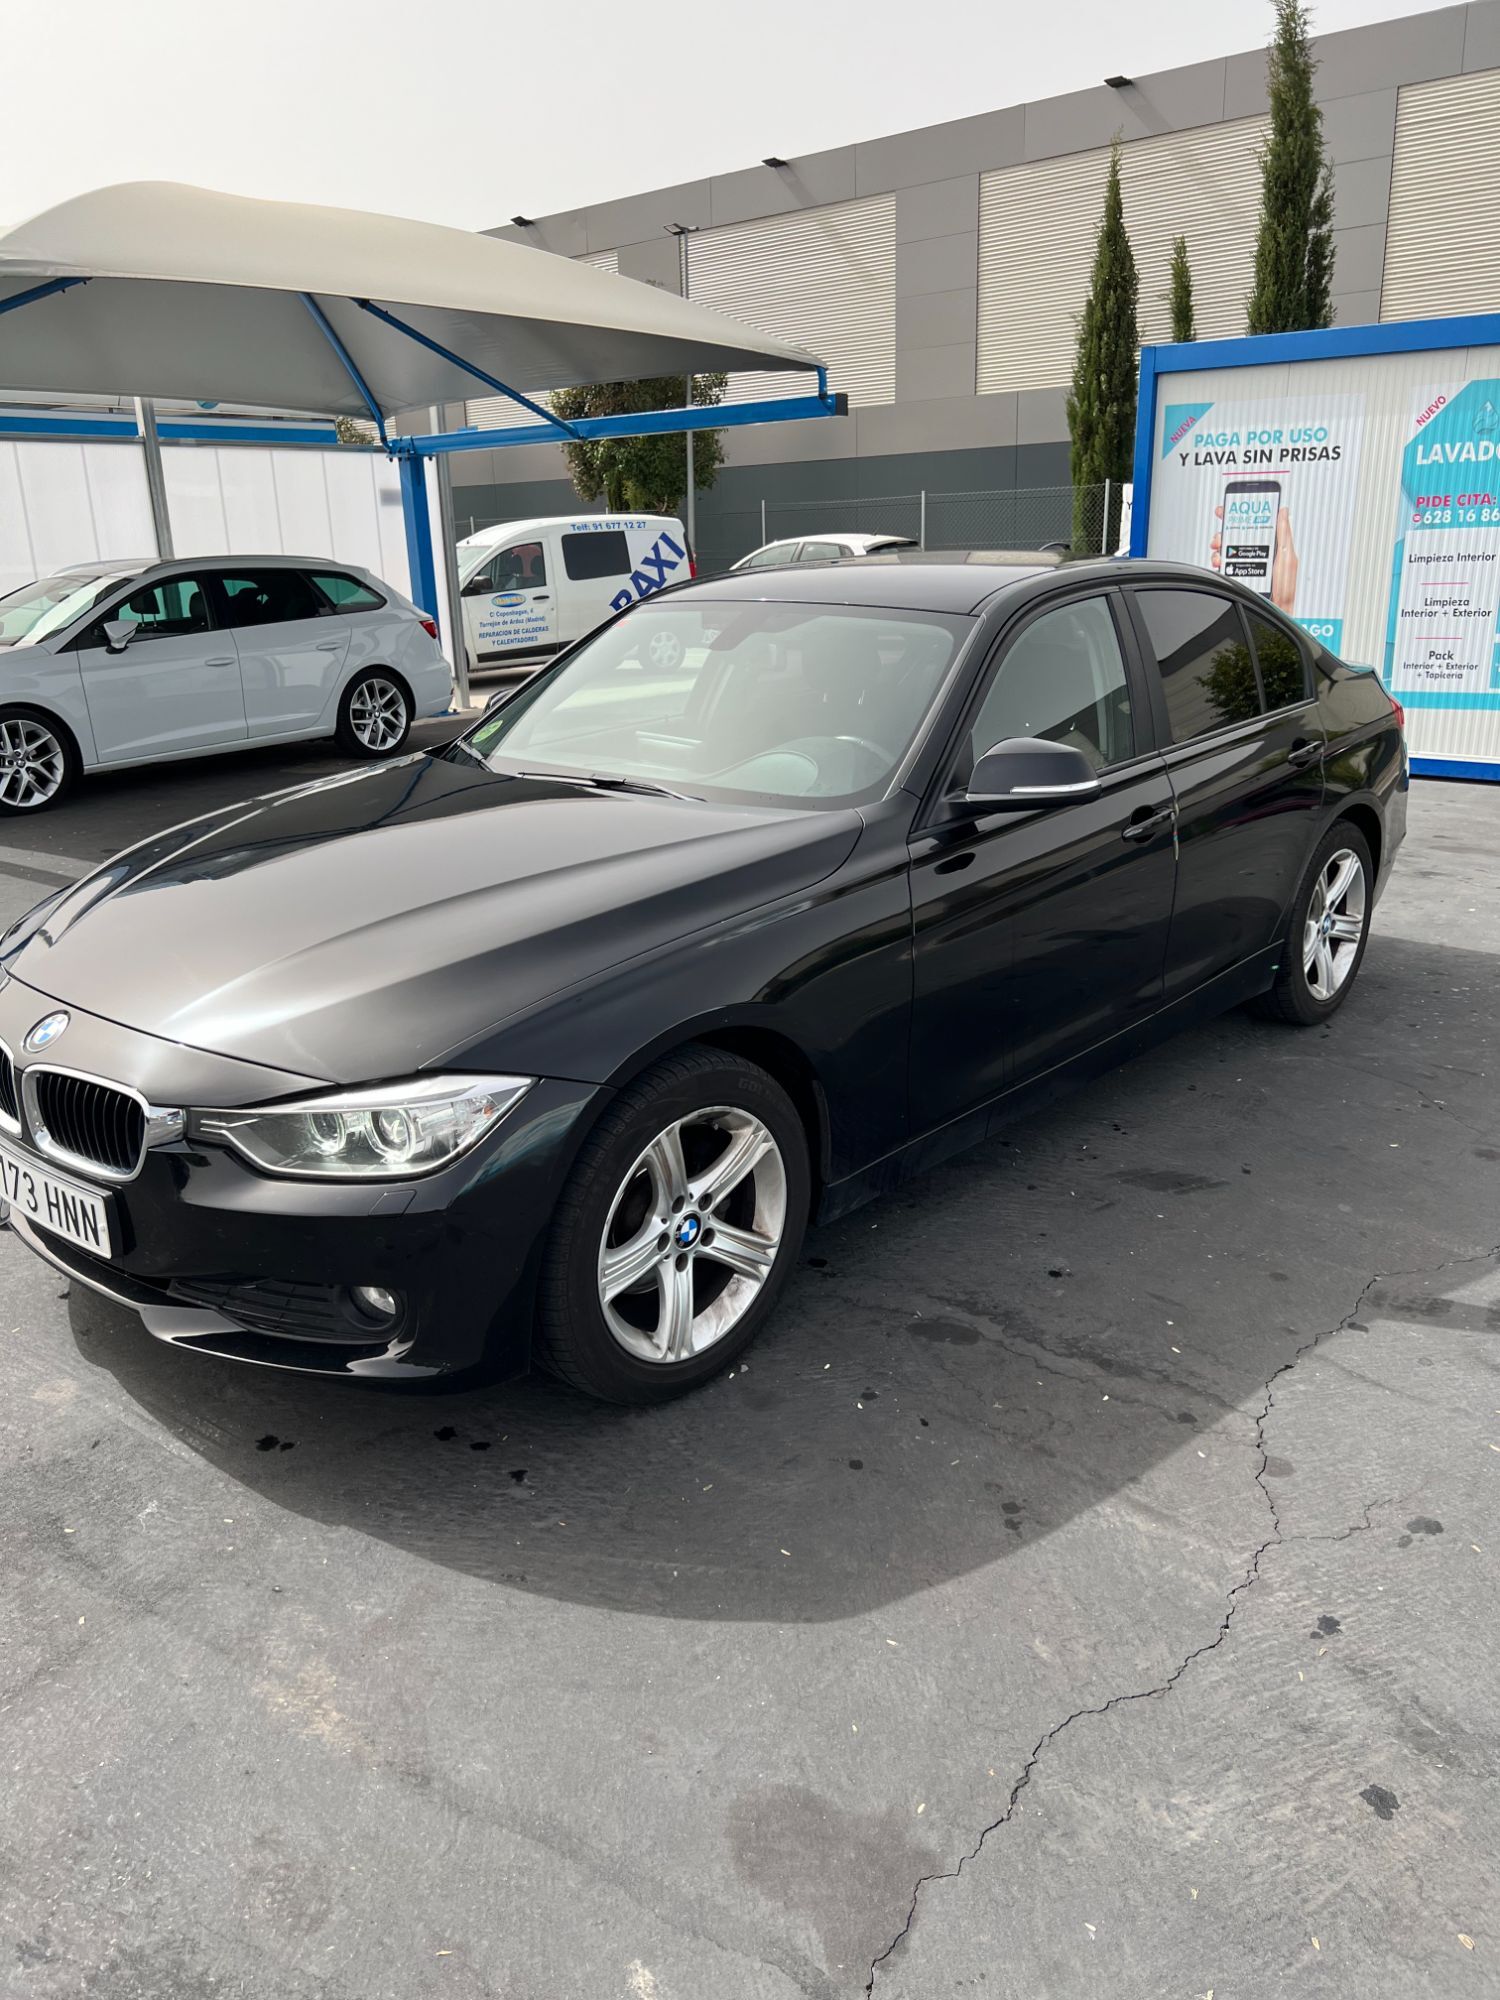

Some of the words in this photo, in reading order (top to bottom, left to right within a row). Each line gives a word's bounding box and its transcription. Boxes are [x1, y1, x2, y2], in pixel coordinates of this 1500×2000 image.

[1416, 396, 1446, 426] NUEVO
[1170, 416, 1196, 444] NUEVA
[1194, 432, 1240, 448] PAGA
[1247, 430, 1283, 445] POR
[1290, 427, 1328, 443] USO
[1179, 453, 1190, 467] Y
[1194, 451, 1237, 466] LAVA
[1243, 449, 1273, 464] SIN
[1279, 446, 1341, 462] PRISAS
[1416, 440, 1500, 465] LAVAD
[1416, 495, 1451, 508] PIDE
[1457, 493, 1497, 506] CITA:
[1229, 501, 1271, 515] AQUA
[1423, 510, 1452, 524] 628
[1458, 509, 1476, 522] 16
[593, 523, 603, 531] 91
[605, 522, 621, 530] 677
[624, 521, 634, 529] 12
[636, 521, 647, 529] 27
[1409, 554, 1454, 565] Limpieza
[1457, 552, 1496, 562] Interior
[1234, 568, 1247, 576] App
[1424, 597, 1470, 608] Limpieza
[1401, 609, 1438, 618] Interior
[1452, 608, 1492, 618] Exterior
[522, 626, 549, 634] CALDERAS
[1428, 650, 1454, 660] Pack
[1403, 662, 1435, 670] Interior
[1446, 662, 1478, 671] Exterior
[44, 1181, 100, 1246] HNN
